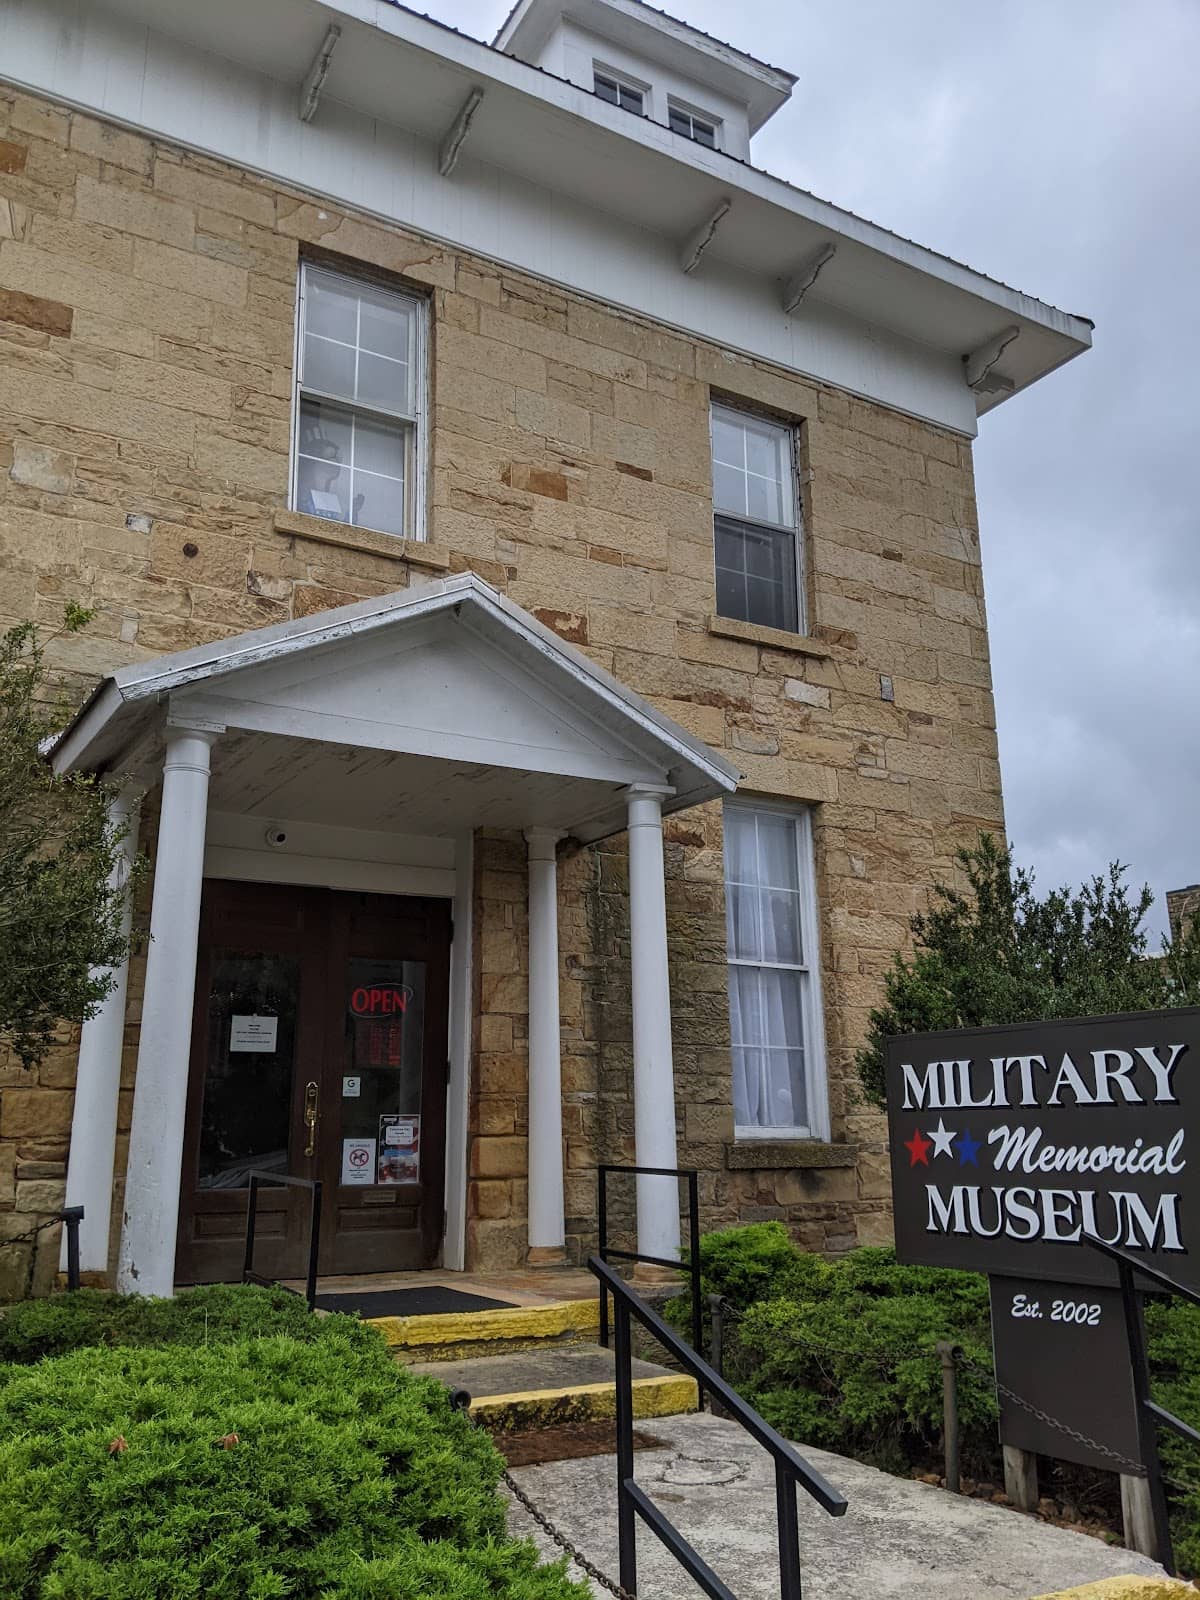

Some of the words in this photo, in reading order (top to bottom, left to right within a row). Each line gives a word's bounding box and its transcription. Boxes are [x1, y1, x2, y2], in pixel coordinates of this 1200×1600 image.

[352, 988, 407, 1013] OPEN
[901, 1044, 1186, 1109] MILITARY
[987, 1124, 1186, 1175] Memorial
[925, 1184, 1185, 1250] MUSEUM
[1010, 1293, 1044, 1319] Est.
[1050, 1298, 1102, 1326] 2002
